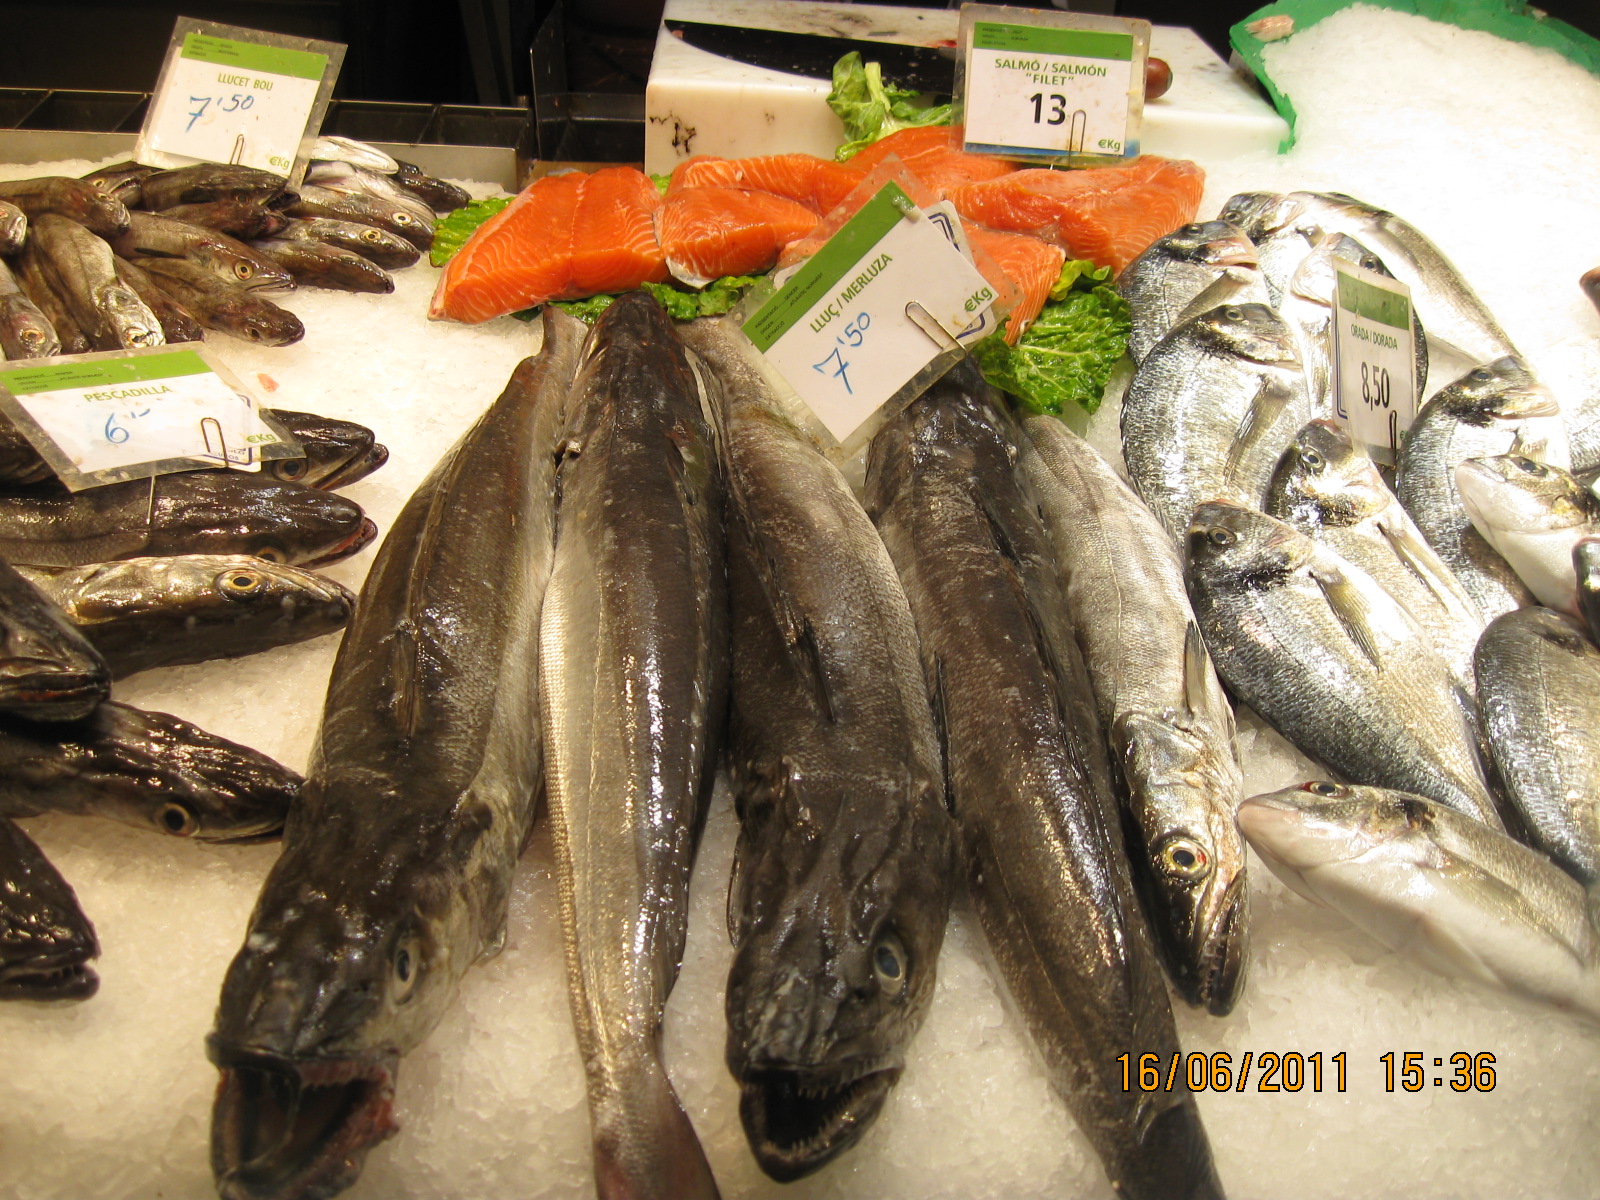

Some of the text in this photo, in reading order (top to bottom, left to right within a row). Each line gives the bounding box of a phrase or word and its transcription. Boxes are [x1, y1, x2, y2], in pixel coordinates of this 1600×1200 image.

[994, 57, 1107, 77] SALMÓ / SALMÓN
[217, 72, 274, 91] LLUCET BOU
[1030, 92, 1067, 125] 13
[1098, 139, 1121, 152] €Kg
[269, 155, 290, 171] €Kg
[809, 253, 894, 334] LLUÇ / MERLUZA
[963, 285, 994, 313] €Kg
[1350, 323, 1369, 342] ORADA
[1373, 333, 1398, 350] DORADA
[82, 383, 173, 403] PESCADILLA
[1361, 361, 1390, 411] 8,50
[246, 432, 277, 444] €Kg
